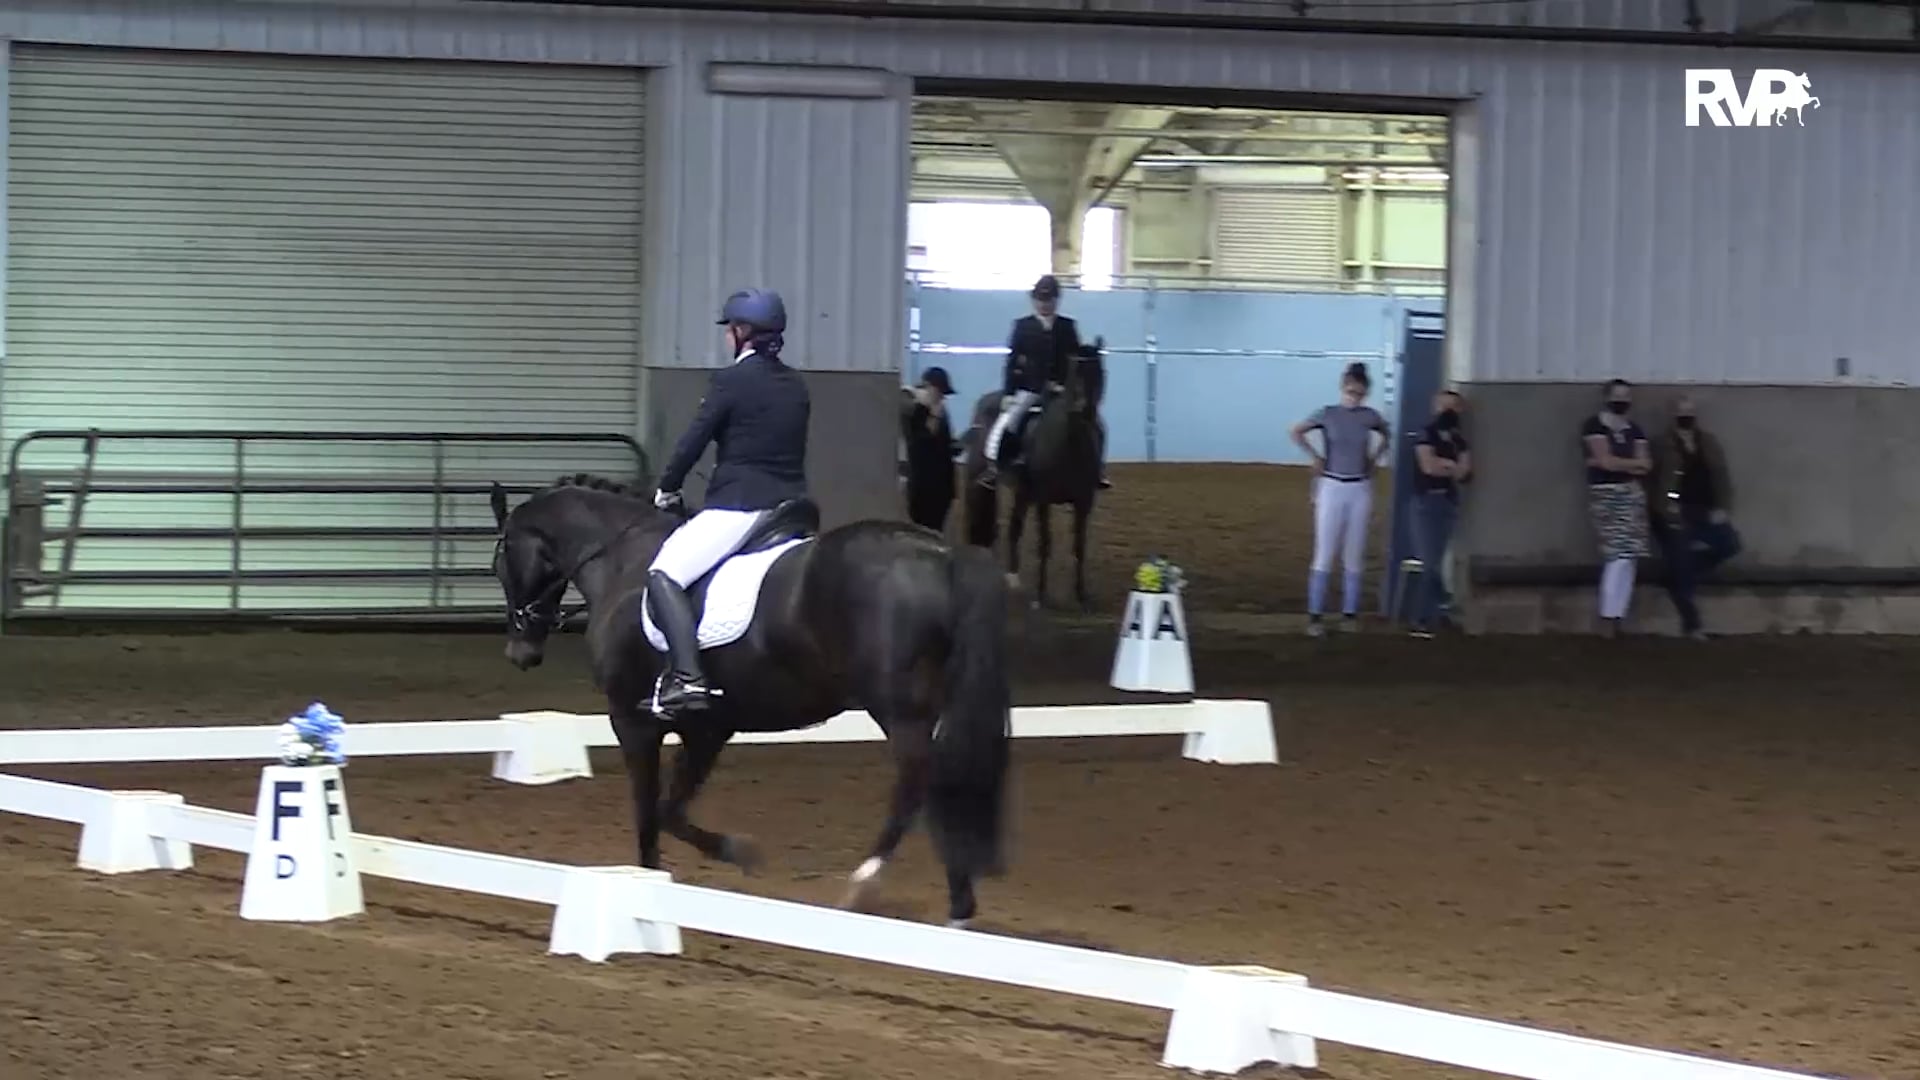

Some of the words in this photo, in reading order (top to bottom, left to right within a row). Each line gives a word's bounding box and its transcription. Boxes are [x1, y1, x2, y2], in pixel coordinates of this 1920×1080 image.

[1120, 599, 1144, 640] A
[1151, 600, 1184, 641] A
[271, 780, 303, 841] F
[322, 779, 341, 841] F
[276, 854, 297, 879] D
